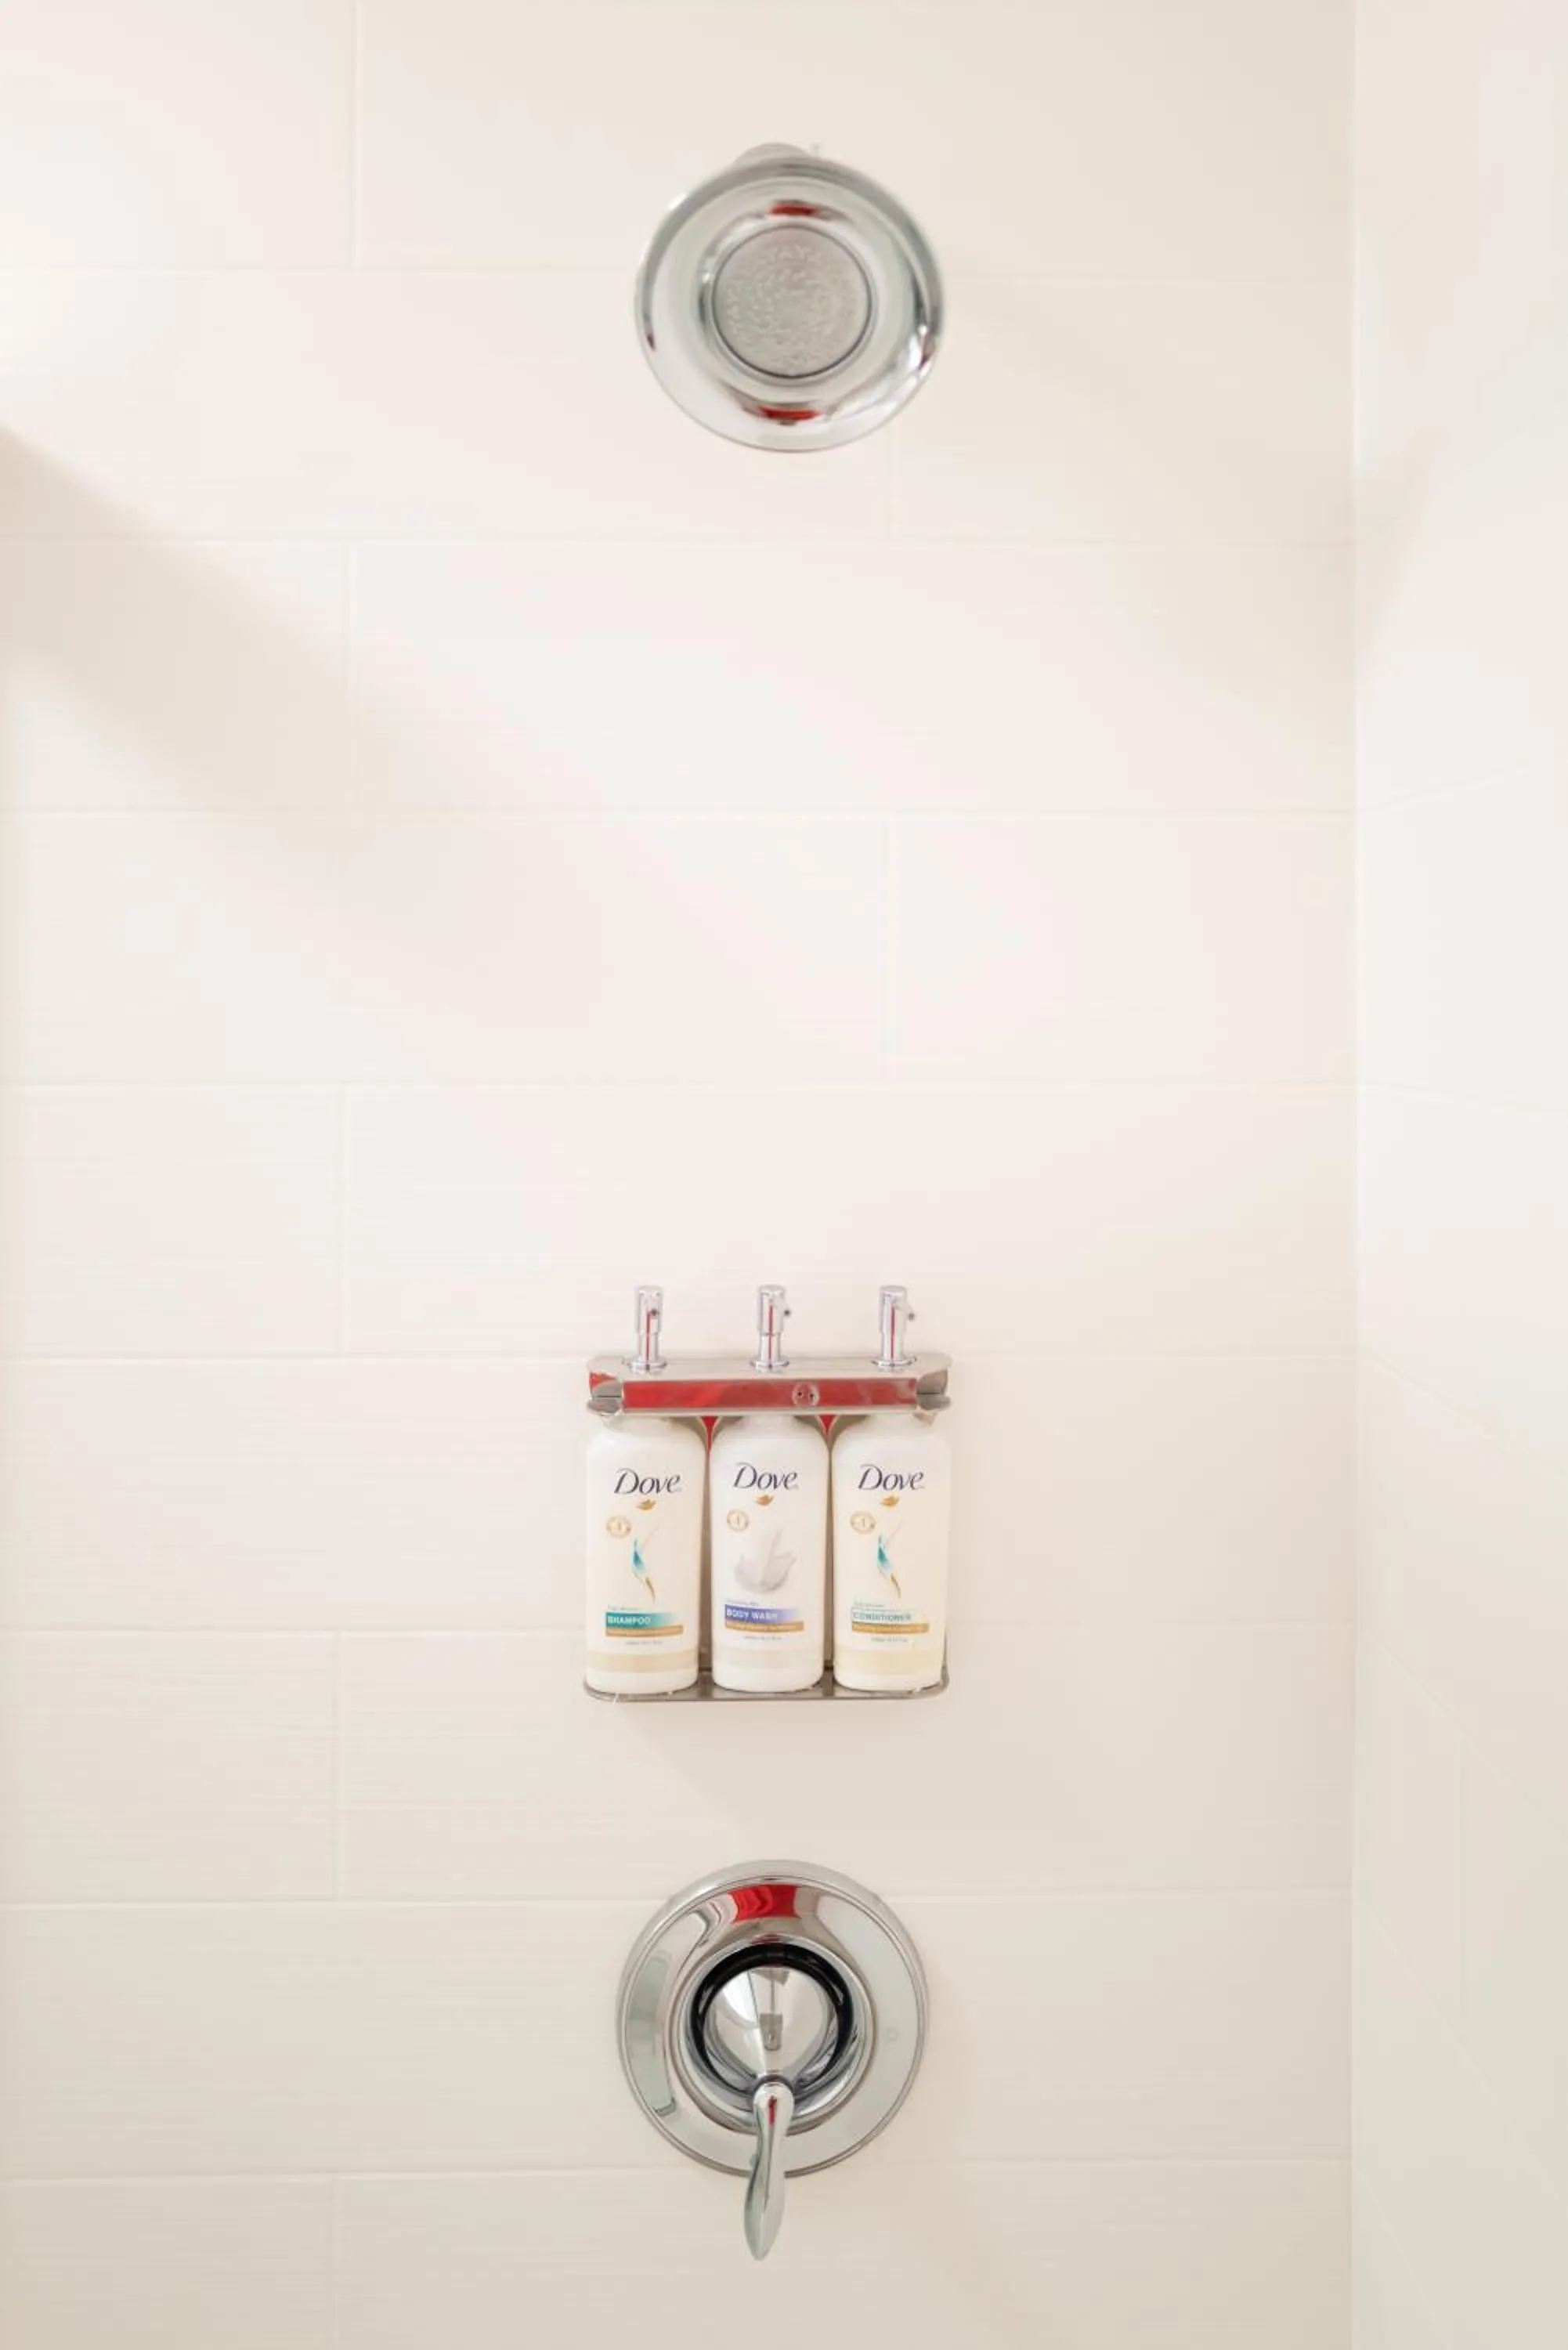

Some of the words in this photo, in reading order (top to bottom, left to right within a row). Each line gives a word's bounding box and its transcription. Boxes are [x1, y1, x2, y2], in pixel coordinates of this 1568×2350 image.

[613, 1467, 681, 1495] Dove
[734, 1462, 798, 1490] Dove
[858, 1464, 924, 1491] Dove
[607, 1615, 651, 1625] SHAMPOO
[726, 1607, 749, 1618] BODY
[751, 1611, 778, 1621] WASH
[852, 1612, 912, 1622] CONDITIONER
